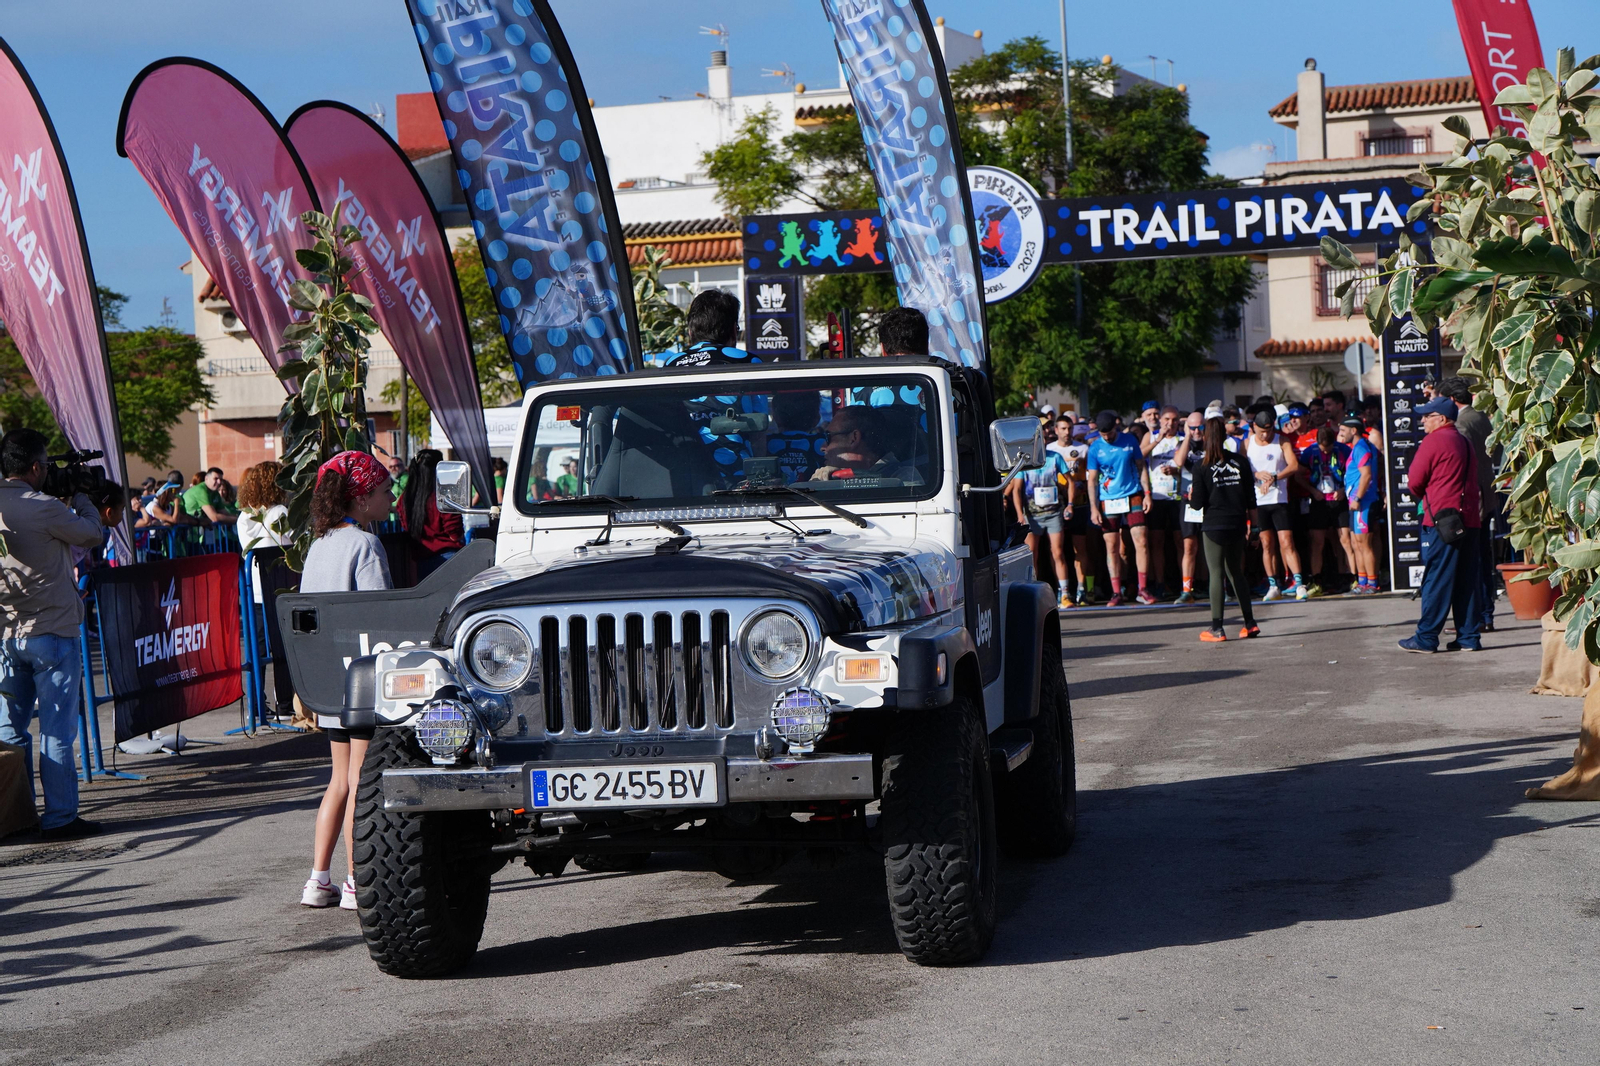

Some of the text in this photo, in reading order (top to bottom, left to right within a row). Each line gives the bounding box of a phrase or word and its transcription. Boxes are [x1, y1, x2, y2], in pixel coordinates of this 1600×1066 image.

[974, 175, 1033, 220] PIRATA
[1079, 190, 1404, 248] TRAIL PIRATA
[1018, 241, 1036, 273] 2023
[984, 282, 1007, 295] OBAL
[757, 341, 789, 349] INAUTO
[1395, 343, 1429, 353] INAUTO
[975, 603, 992, 648] Jeep
[135, 622, 210, 667] TEAMERGY
[609, 743, 665, 757] Jeep
[537, 792, 544, 800] E
[594, 771, 665, 800] 2455
[668, 769, 705, 799] BV
